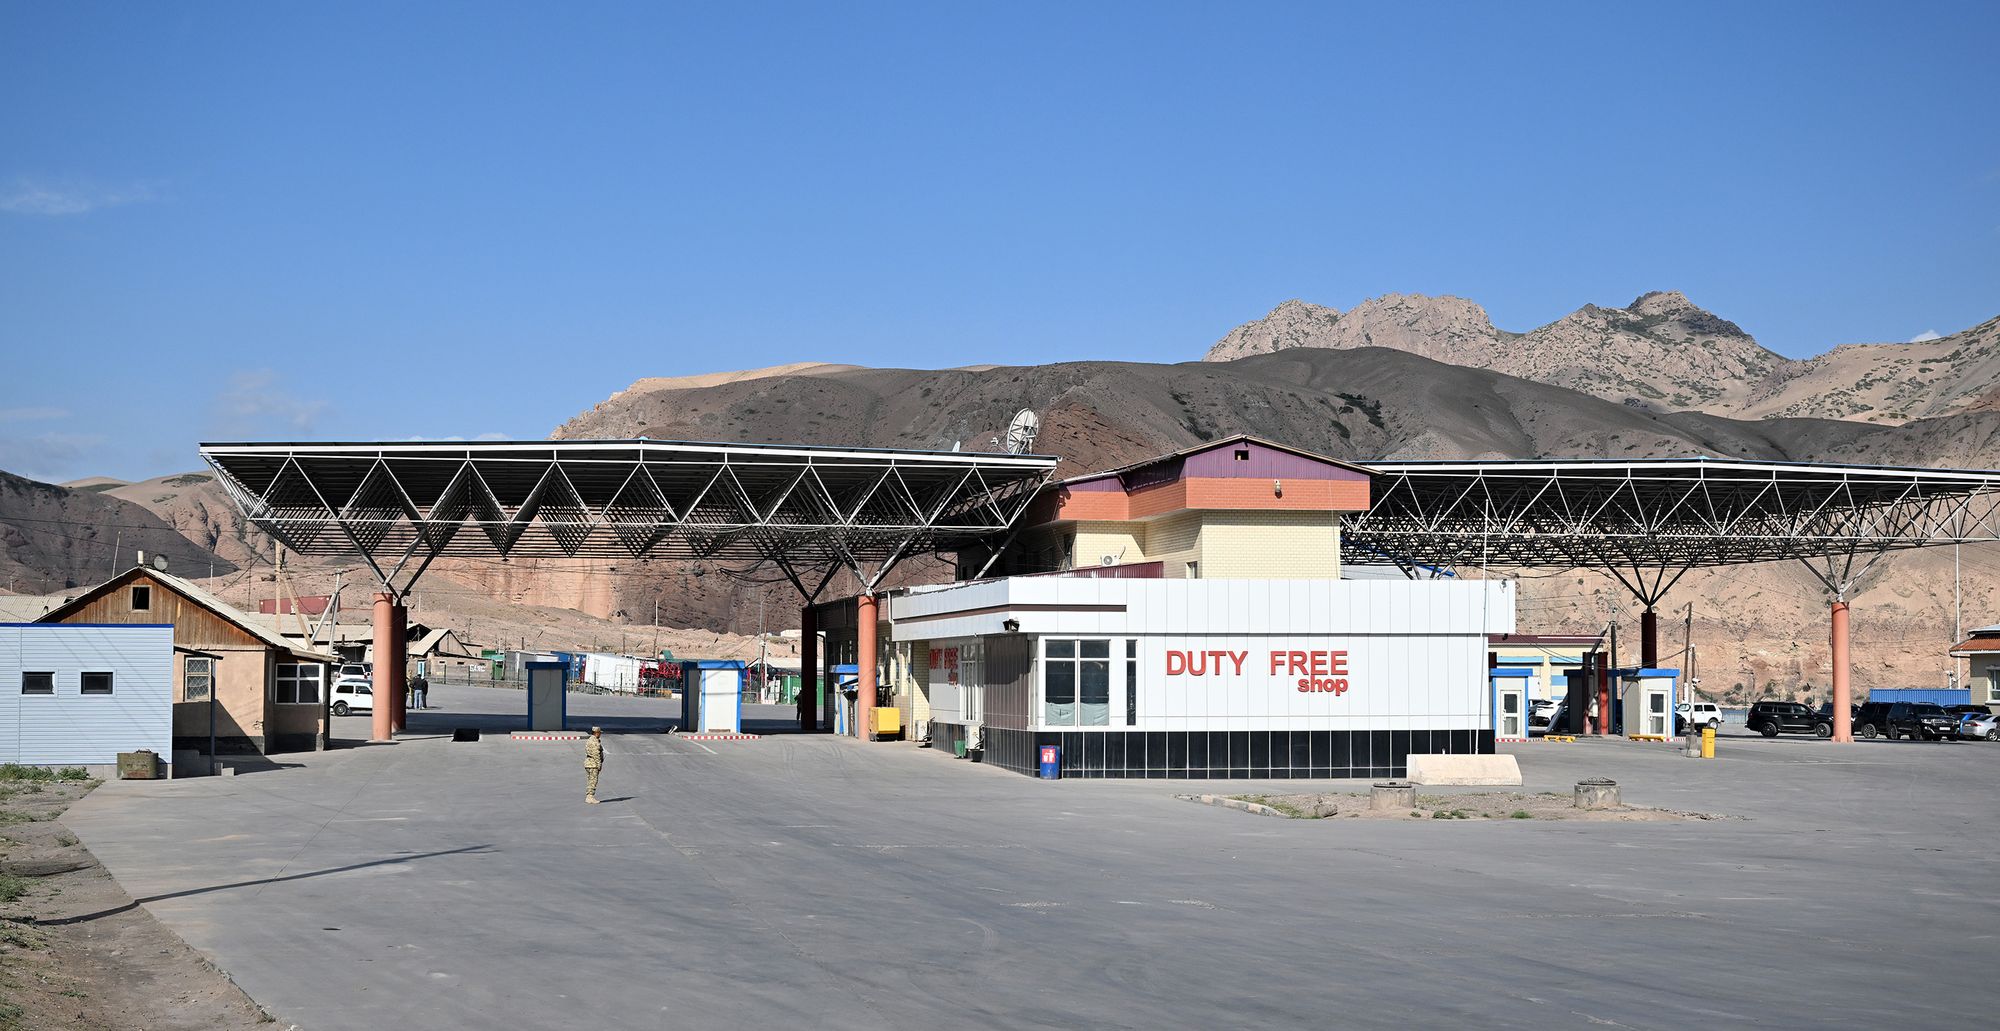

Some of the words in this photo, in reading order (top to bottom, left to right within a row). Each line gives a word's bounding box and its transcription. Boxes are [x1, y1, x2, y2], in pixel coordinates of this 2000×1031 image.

[1166, 650, 1248, 676] DUTY
[1270, 650, 1348, 676] FREE
[1297, 675, 1348, 697] shop
